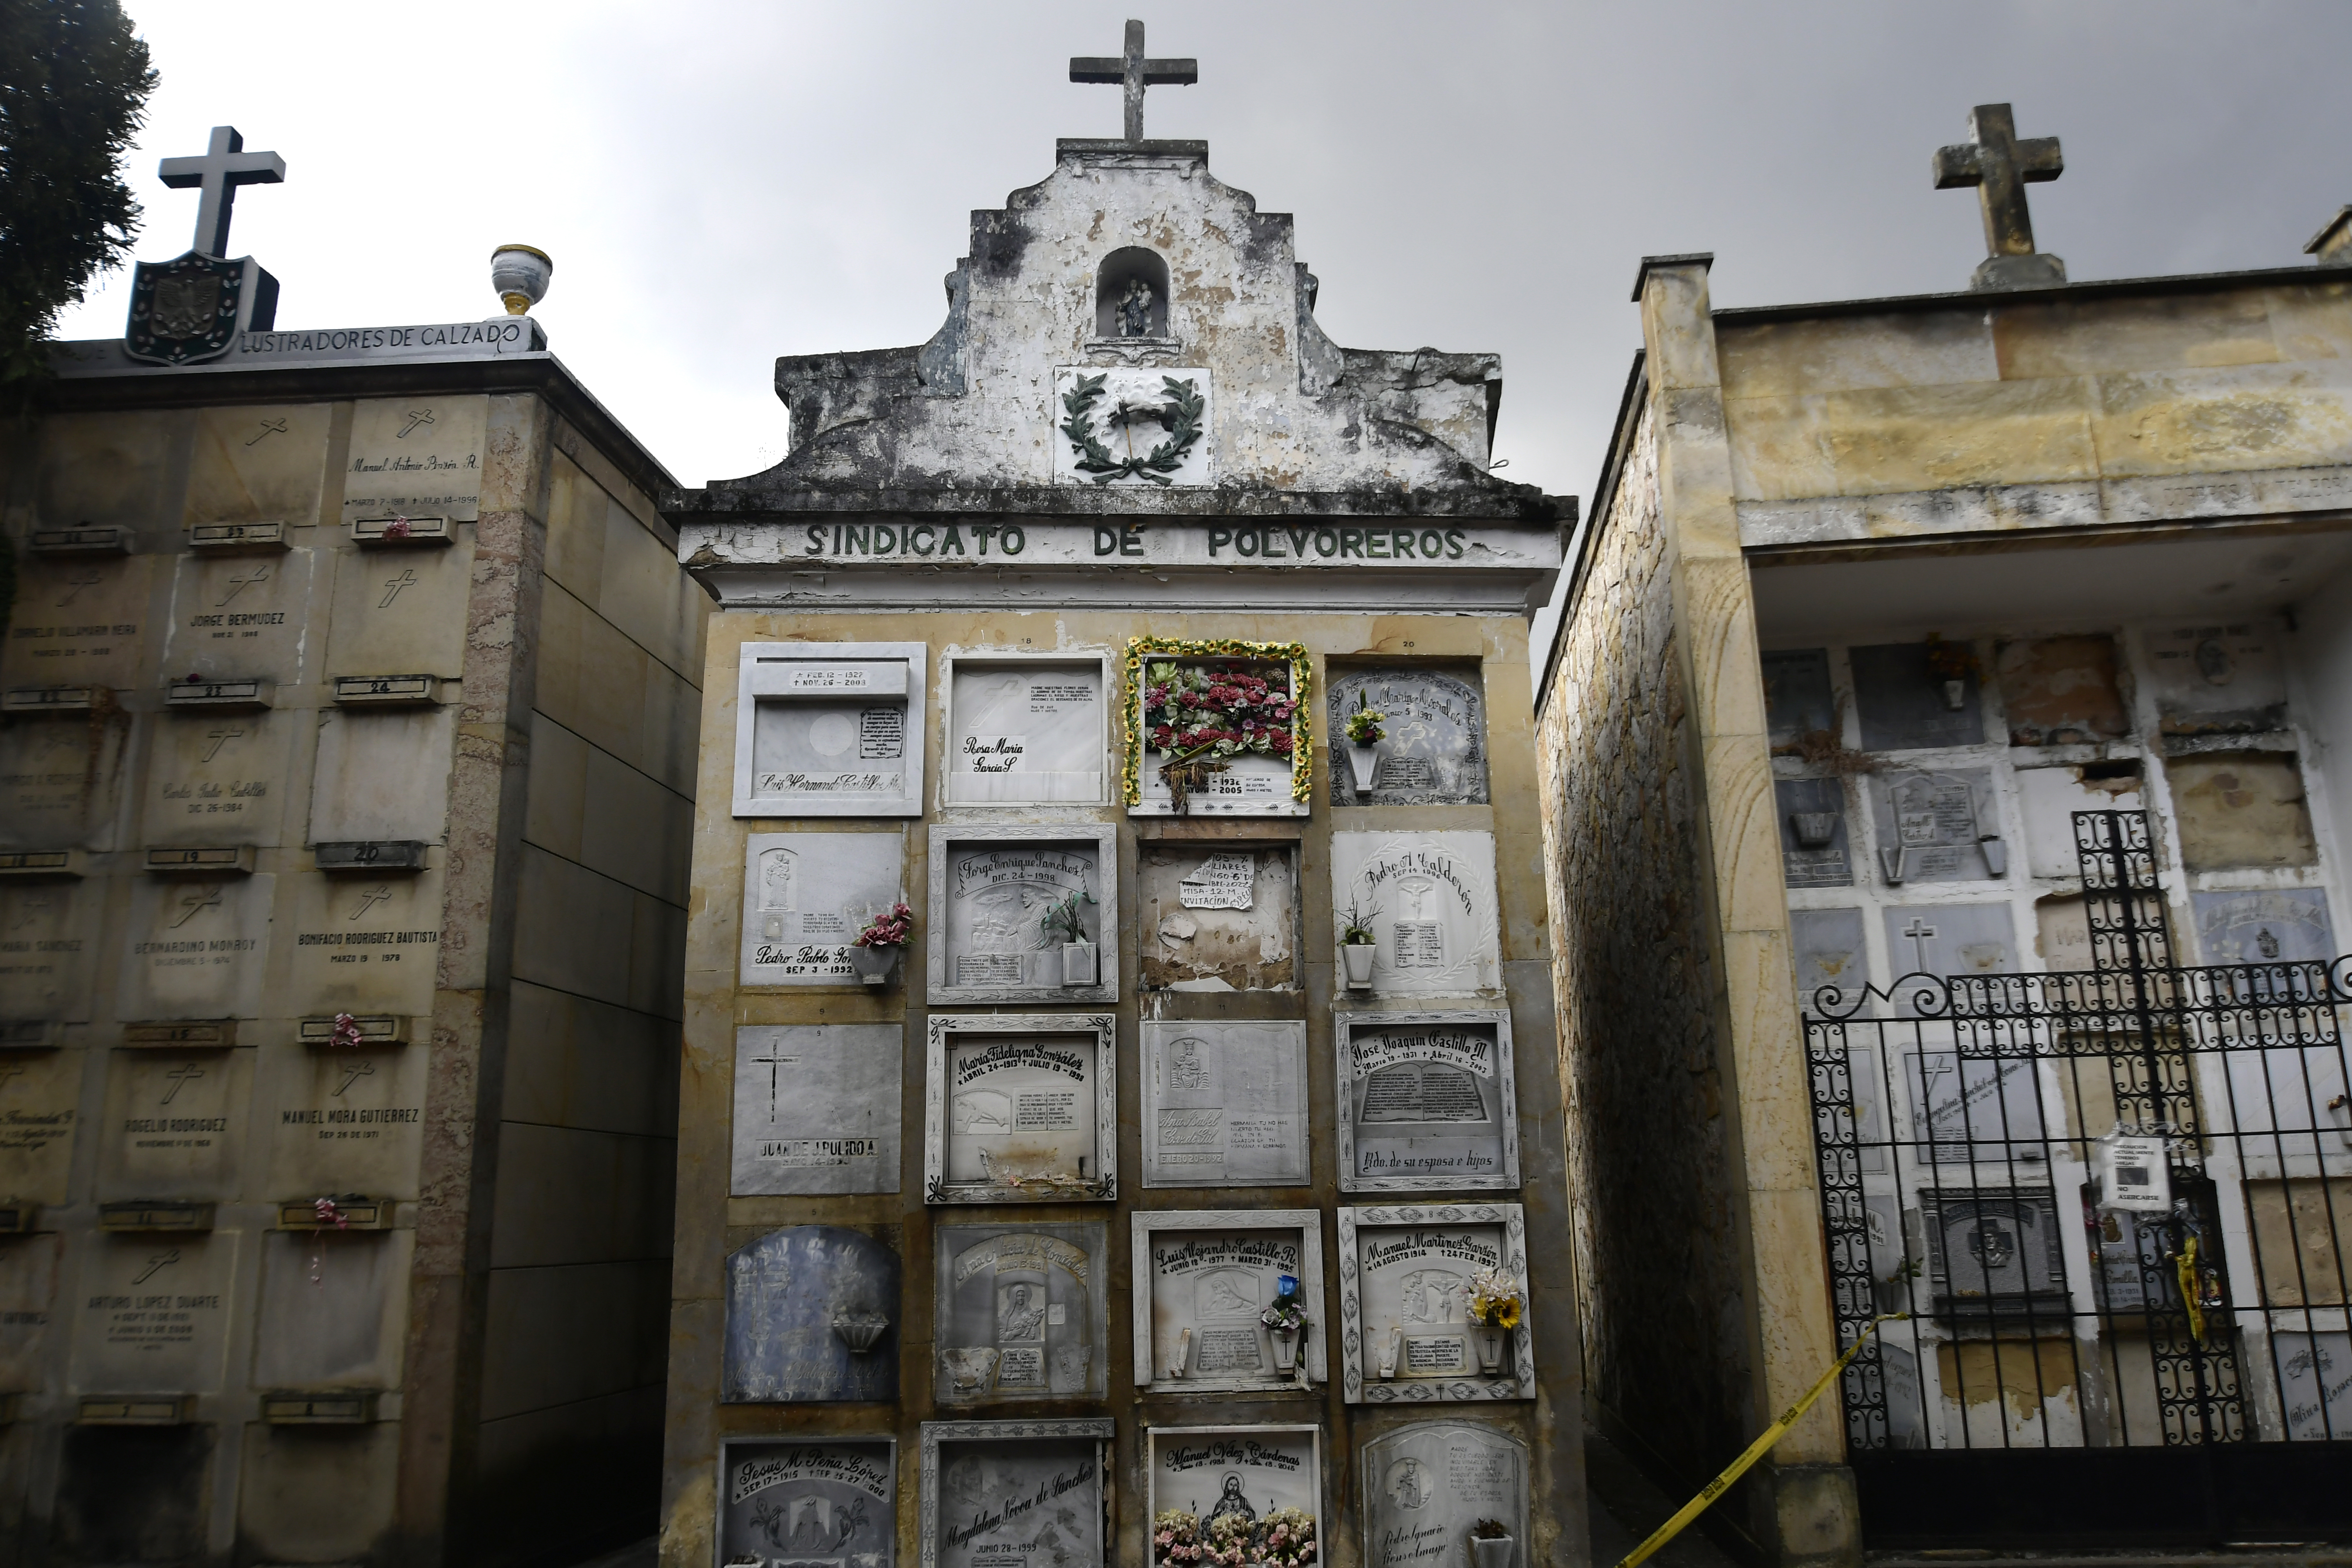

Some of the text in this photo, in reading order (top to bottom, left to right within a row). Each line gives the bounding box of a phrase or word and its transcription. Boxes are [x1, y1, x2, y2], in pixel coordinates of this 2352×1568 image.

[241, 324, 520, 353] LUSTRADORES DE CALZADO
[349, 458, 387, 473] Manuel
[390, 456, 424, 471] Antonio
[806, 525, 1466, 559] SINDICATO DE POLVOREROS
[190, 613, 284, 626] JORGE BERMUDEZ
[370, 682, 390, 692] 24
[1418, 710, 1432, 721] 1993
[963, 736, 990, 754] Rosa
[973, 757, 1003, 772] Garcia
[757, 774, 784, 791] Luis
[784, 774, 839, 792] Hernando
[183, 852, 199, 862] 19
[354, 847, 379, 860] 20
[962, 852, 1081, 879] Jorge Enrique Sanchez
[1393, 869, 1406, 878] SEP
[1423, 869, 1440, 879] 1996
[992, 873, 1009, 883] DIC.
[1035, 872, 1055, 882] 1998
[345, 932, 394, 944] RODRIGUEZ
[397, 931, 437, 942] BAUTISTA
[755, 944, 830, 964] Pedro Pablo
[1351, 1042, 1380, 1068] José
[1428, 1029, 1471, 1053] Castillo
[958, 1053, 988, 1075] María
[1429, 1051, 1453, 1061] Abril
[1469, 1062, 1488, 1073] 2003
[963, 1067, 986, 1084] ABRIL
[1028, 1059, 1050, 1069] JULIO
[1069, 1069, 1084, 1082] 1998
[282, 1109, 419, 1125] MANUEL MORA GUTIERREZ
[1159, 1110, 1184, 1127] Ana
[1197, 1129, 1219, 1144] Gil
[1387, 1151, 1401, 1168] de
[1404, 1158, 1416, 1167] su
[1418, 1155, 1453, 1172] esposa
[1466, 1150, 1492, 1170] hijos
[1156, 1248, 1185, 1268] Luis
[1183, 1238, 1238, 1262] Alejandro
[1236, 1238, 1281, 1260] Castillo
[1365, 1235, 1411, 1264] Manuel
[1383, 1252, 1409, 1265] AGOSTO
[1410, 1249, 1427, 1258] 1914
[1459, 1252, 1477, 1262] FEB.
[1479, 1257, 1496, 1268] 1997
[1169, 1260, 1189, 1274] JUNIO
[1209, 1255, 1224, 1264] 1977
[1238, 1255, 1262, 1265] MARZO
[1277, 1261, 1294, 1273] 1995
[1166, 1446, 1211, 1468] Manuel
[1246, 1441, 1300, 1466] Cárdenas
[744, 1482, 761, 1495] SEP.
[943, 1509, 1001, 1552] Magdalena
[1034, 1481, 1049, 1507] de
[976, 1544, 998, 1553] JUNIO
